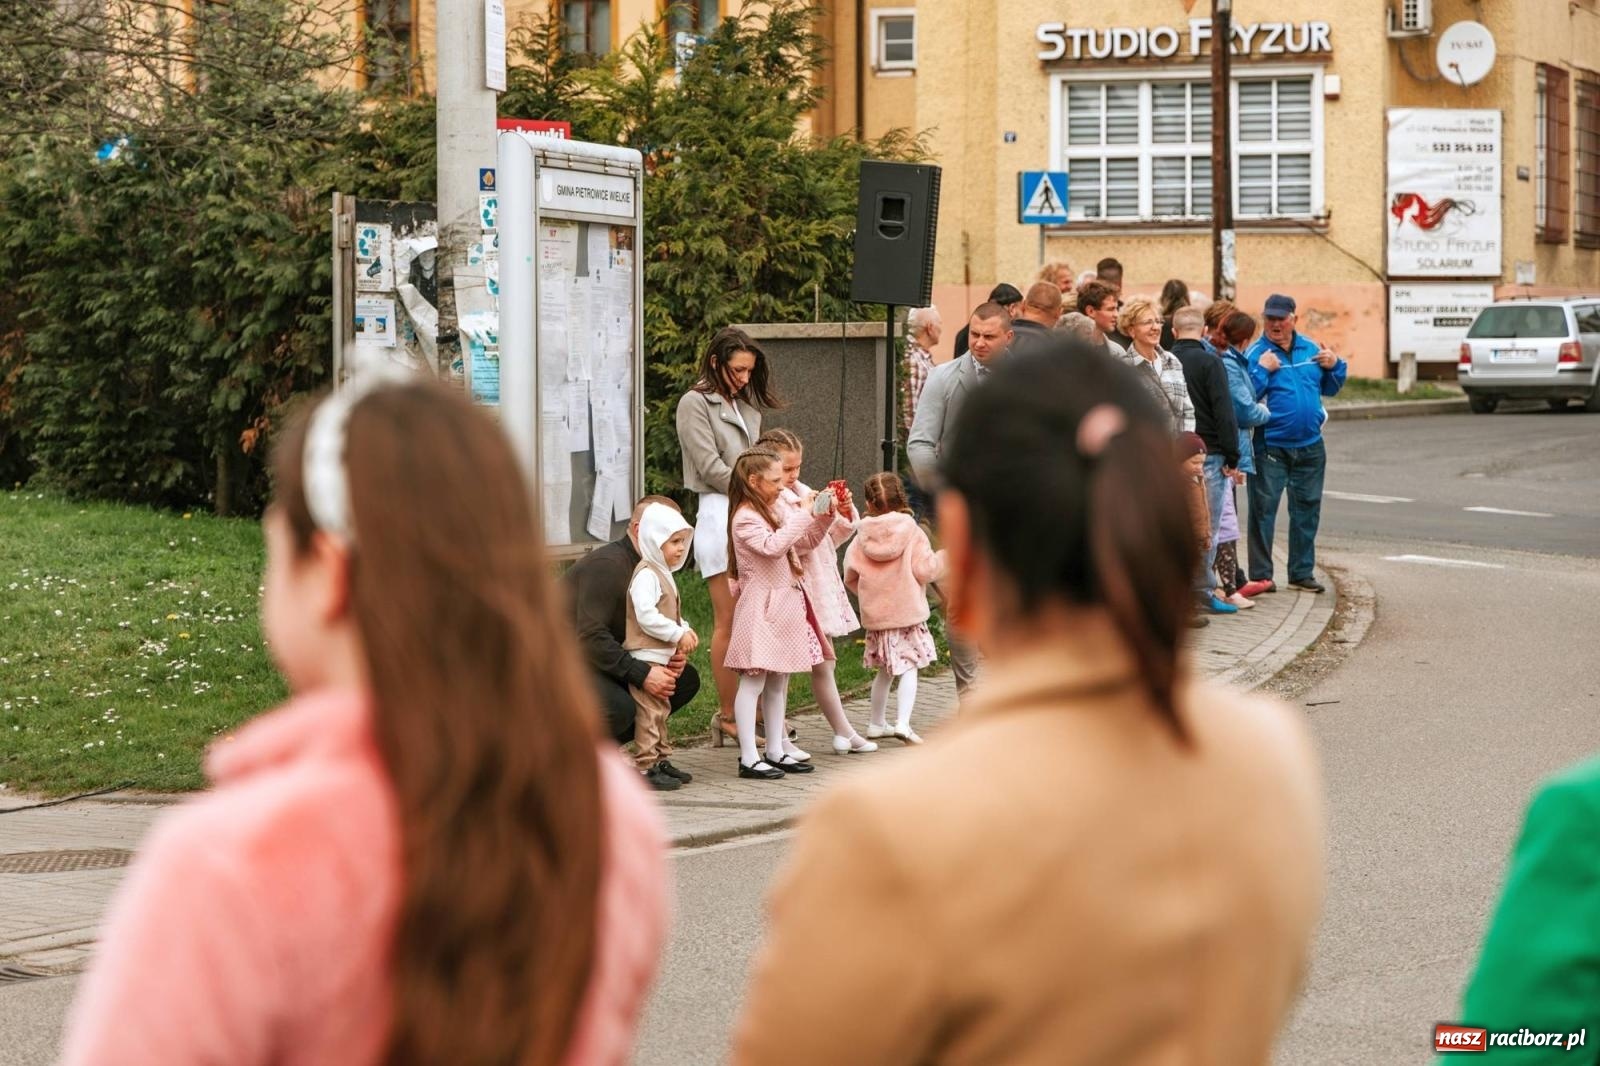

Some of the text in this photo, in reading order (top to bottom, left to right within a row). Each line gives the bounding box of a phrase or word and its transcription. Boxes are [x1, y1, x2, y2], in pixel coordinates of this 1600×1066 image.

[1036, 22, 1180, 60] STUDIO
[557, 184, 631, 203] GMINA PIETROWICE WIELKIE
[1416, 257, 1474, 270] SOLARIUM
